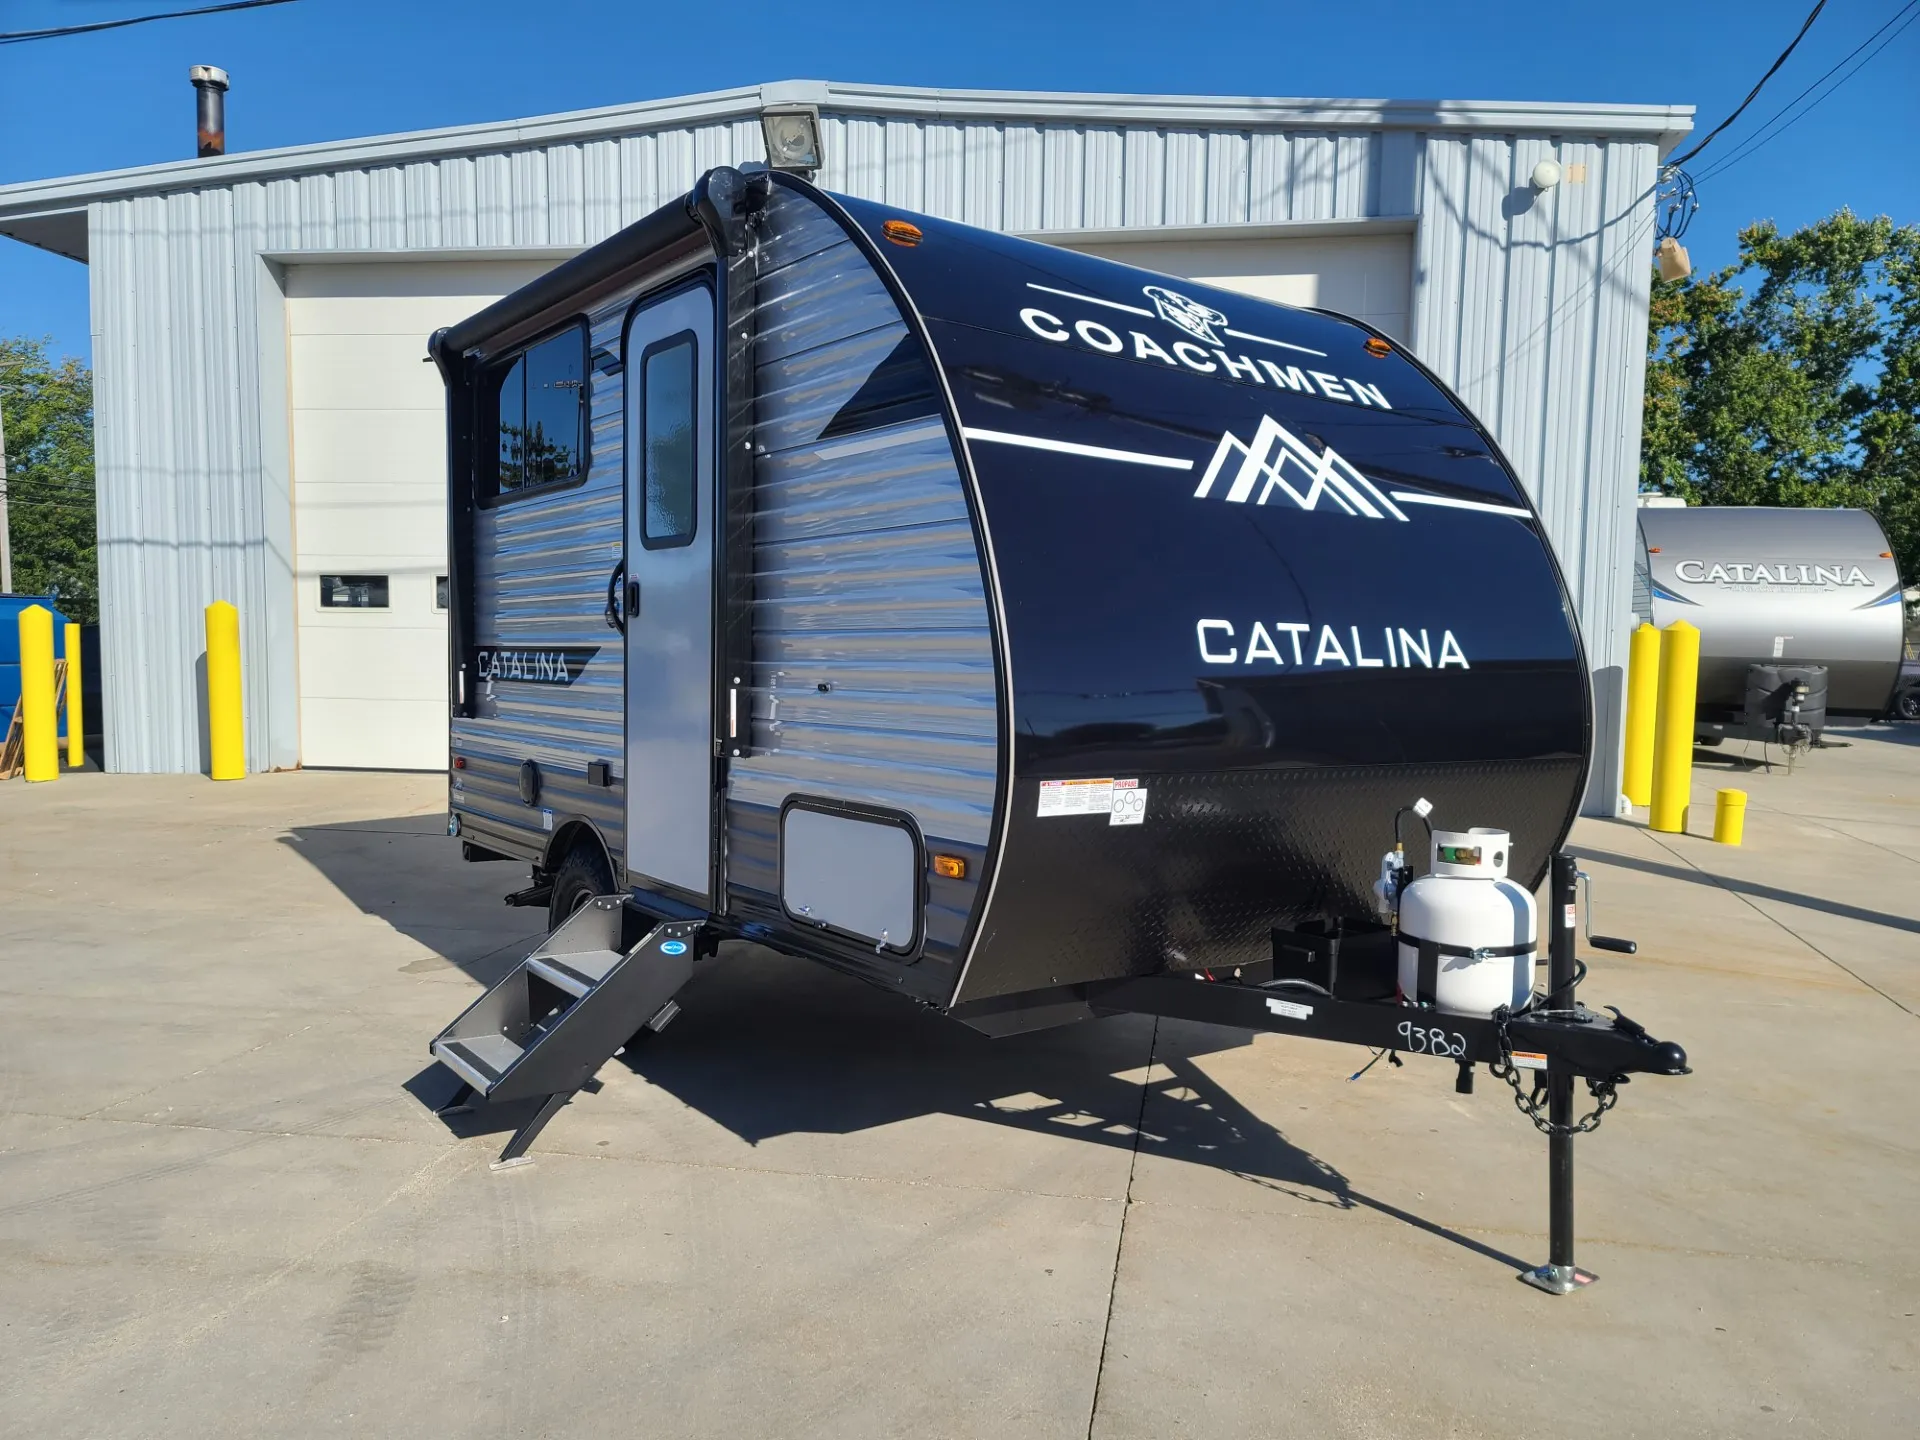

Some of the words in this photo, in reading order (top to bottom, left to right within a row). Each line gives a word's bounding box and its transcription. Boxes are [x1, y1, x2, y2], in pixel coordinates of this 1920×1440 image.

[1019, 307, 1392, 410] COACHMEN
[1674, 559, 1875, 587] CATALINA
[1196, 618, 1470, 670] CATALINA
[478, 652, 569, 681] CATALINA
[1115, 780, 1137, 788] PROPANE
[1397, 1020, 1467, 1060] 9382
